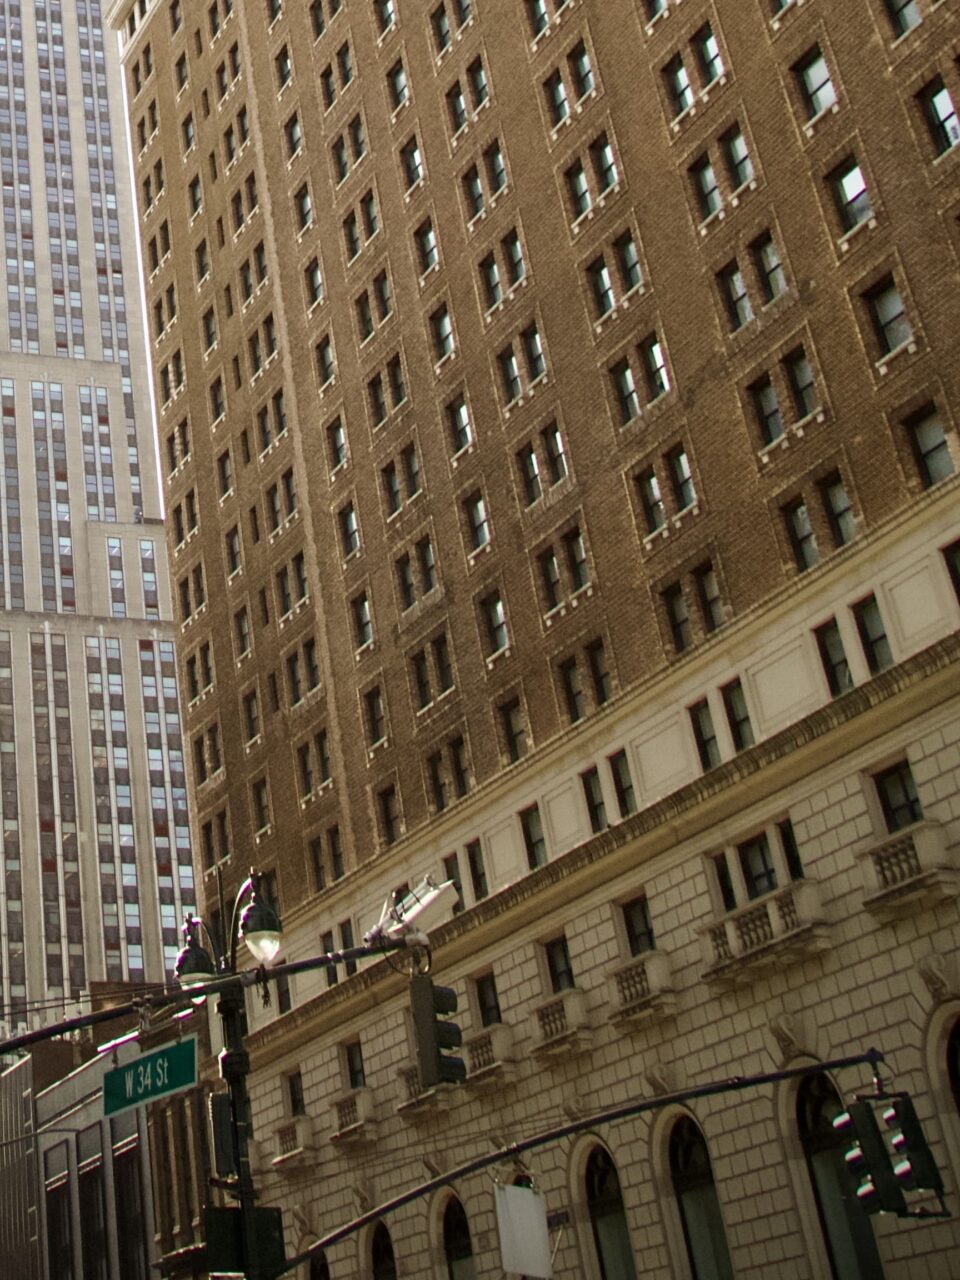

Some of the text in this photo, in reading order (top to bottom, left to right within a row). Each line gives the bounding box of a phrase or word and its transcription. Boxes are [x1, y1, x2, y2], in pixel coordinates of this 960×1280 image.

[125, 1057, 169, 1099] W 34 St
